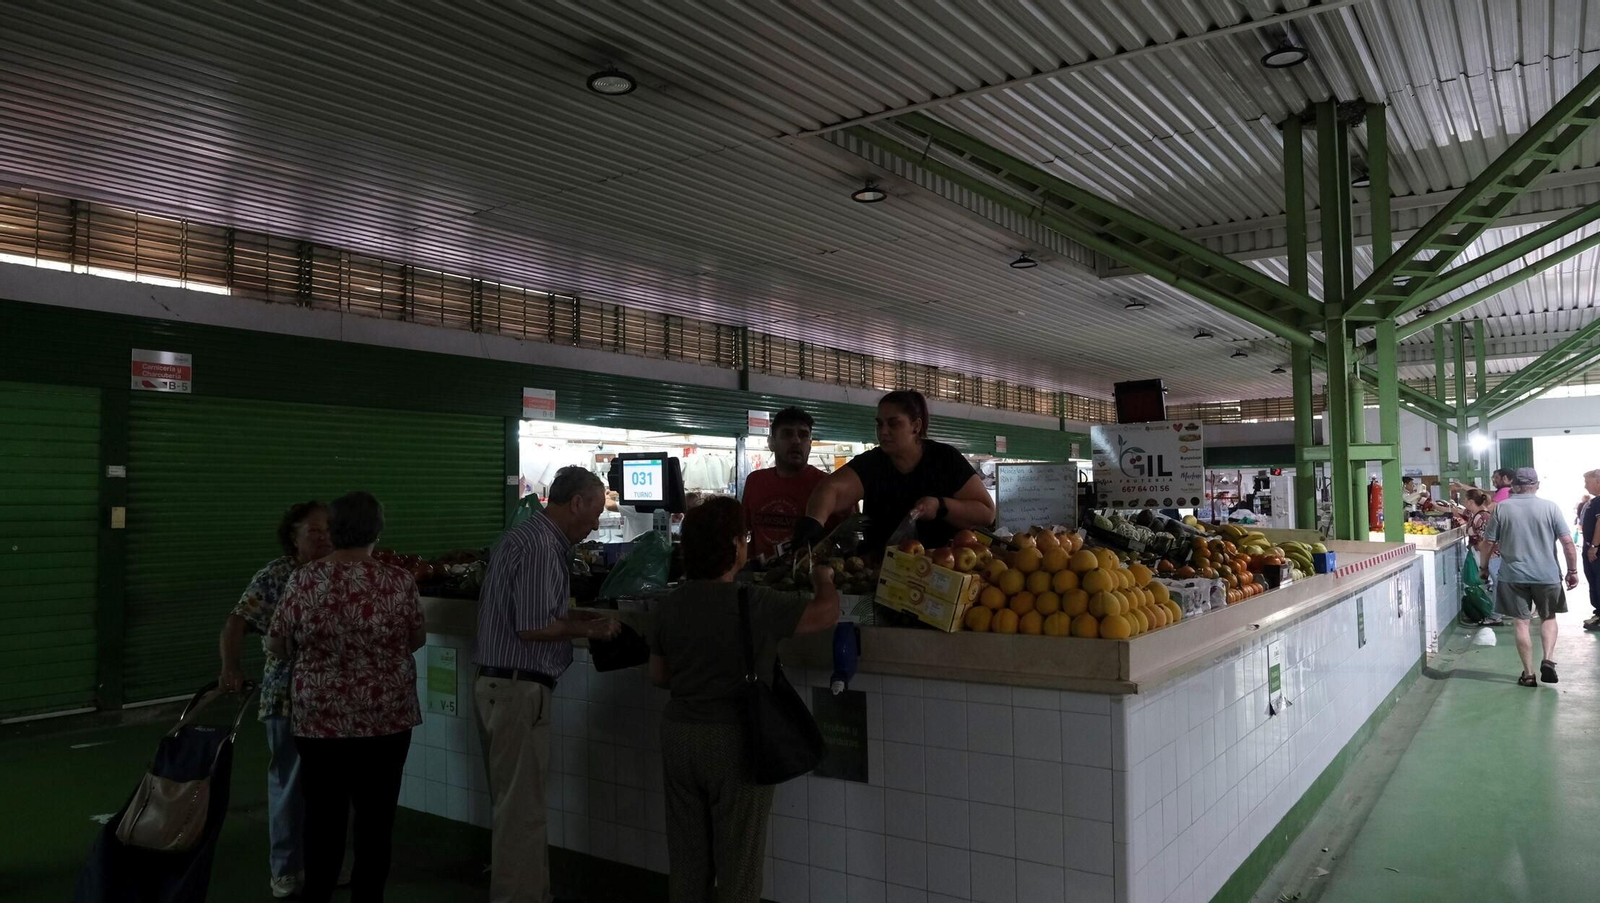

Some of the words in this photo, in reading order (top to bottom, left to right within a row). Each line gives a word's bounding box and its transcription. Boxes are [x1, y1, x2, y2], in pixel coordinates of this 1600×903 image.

[169, 381, 188, 391] B-5
[1119, 446, 1173, 478] GIL
[631, 471, 652, 486] 031
[1121, 485, 1136, 493] 667
[1137, 485, 1148, 493] 64
[1159, 484, 1170, 492] 56
[440, 700, 455, 713] V-5
[823, 722, 850, 734] Frutas
[852, 727, 858, 737] y
